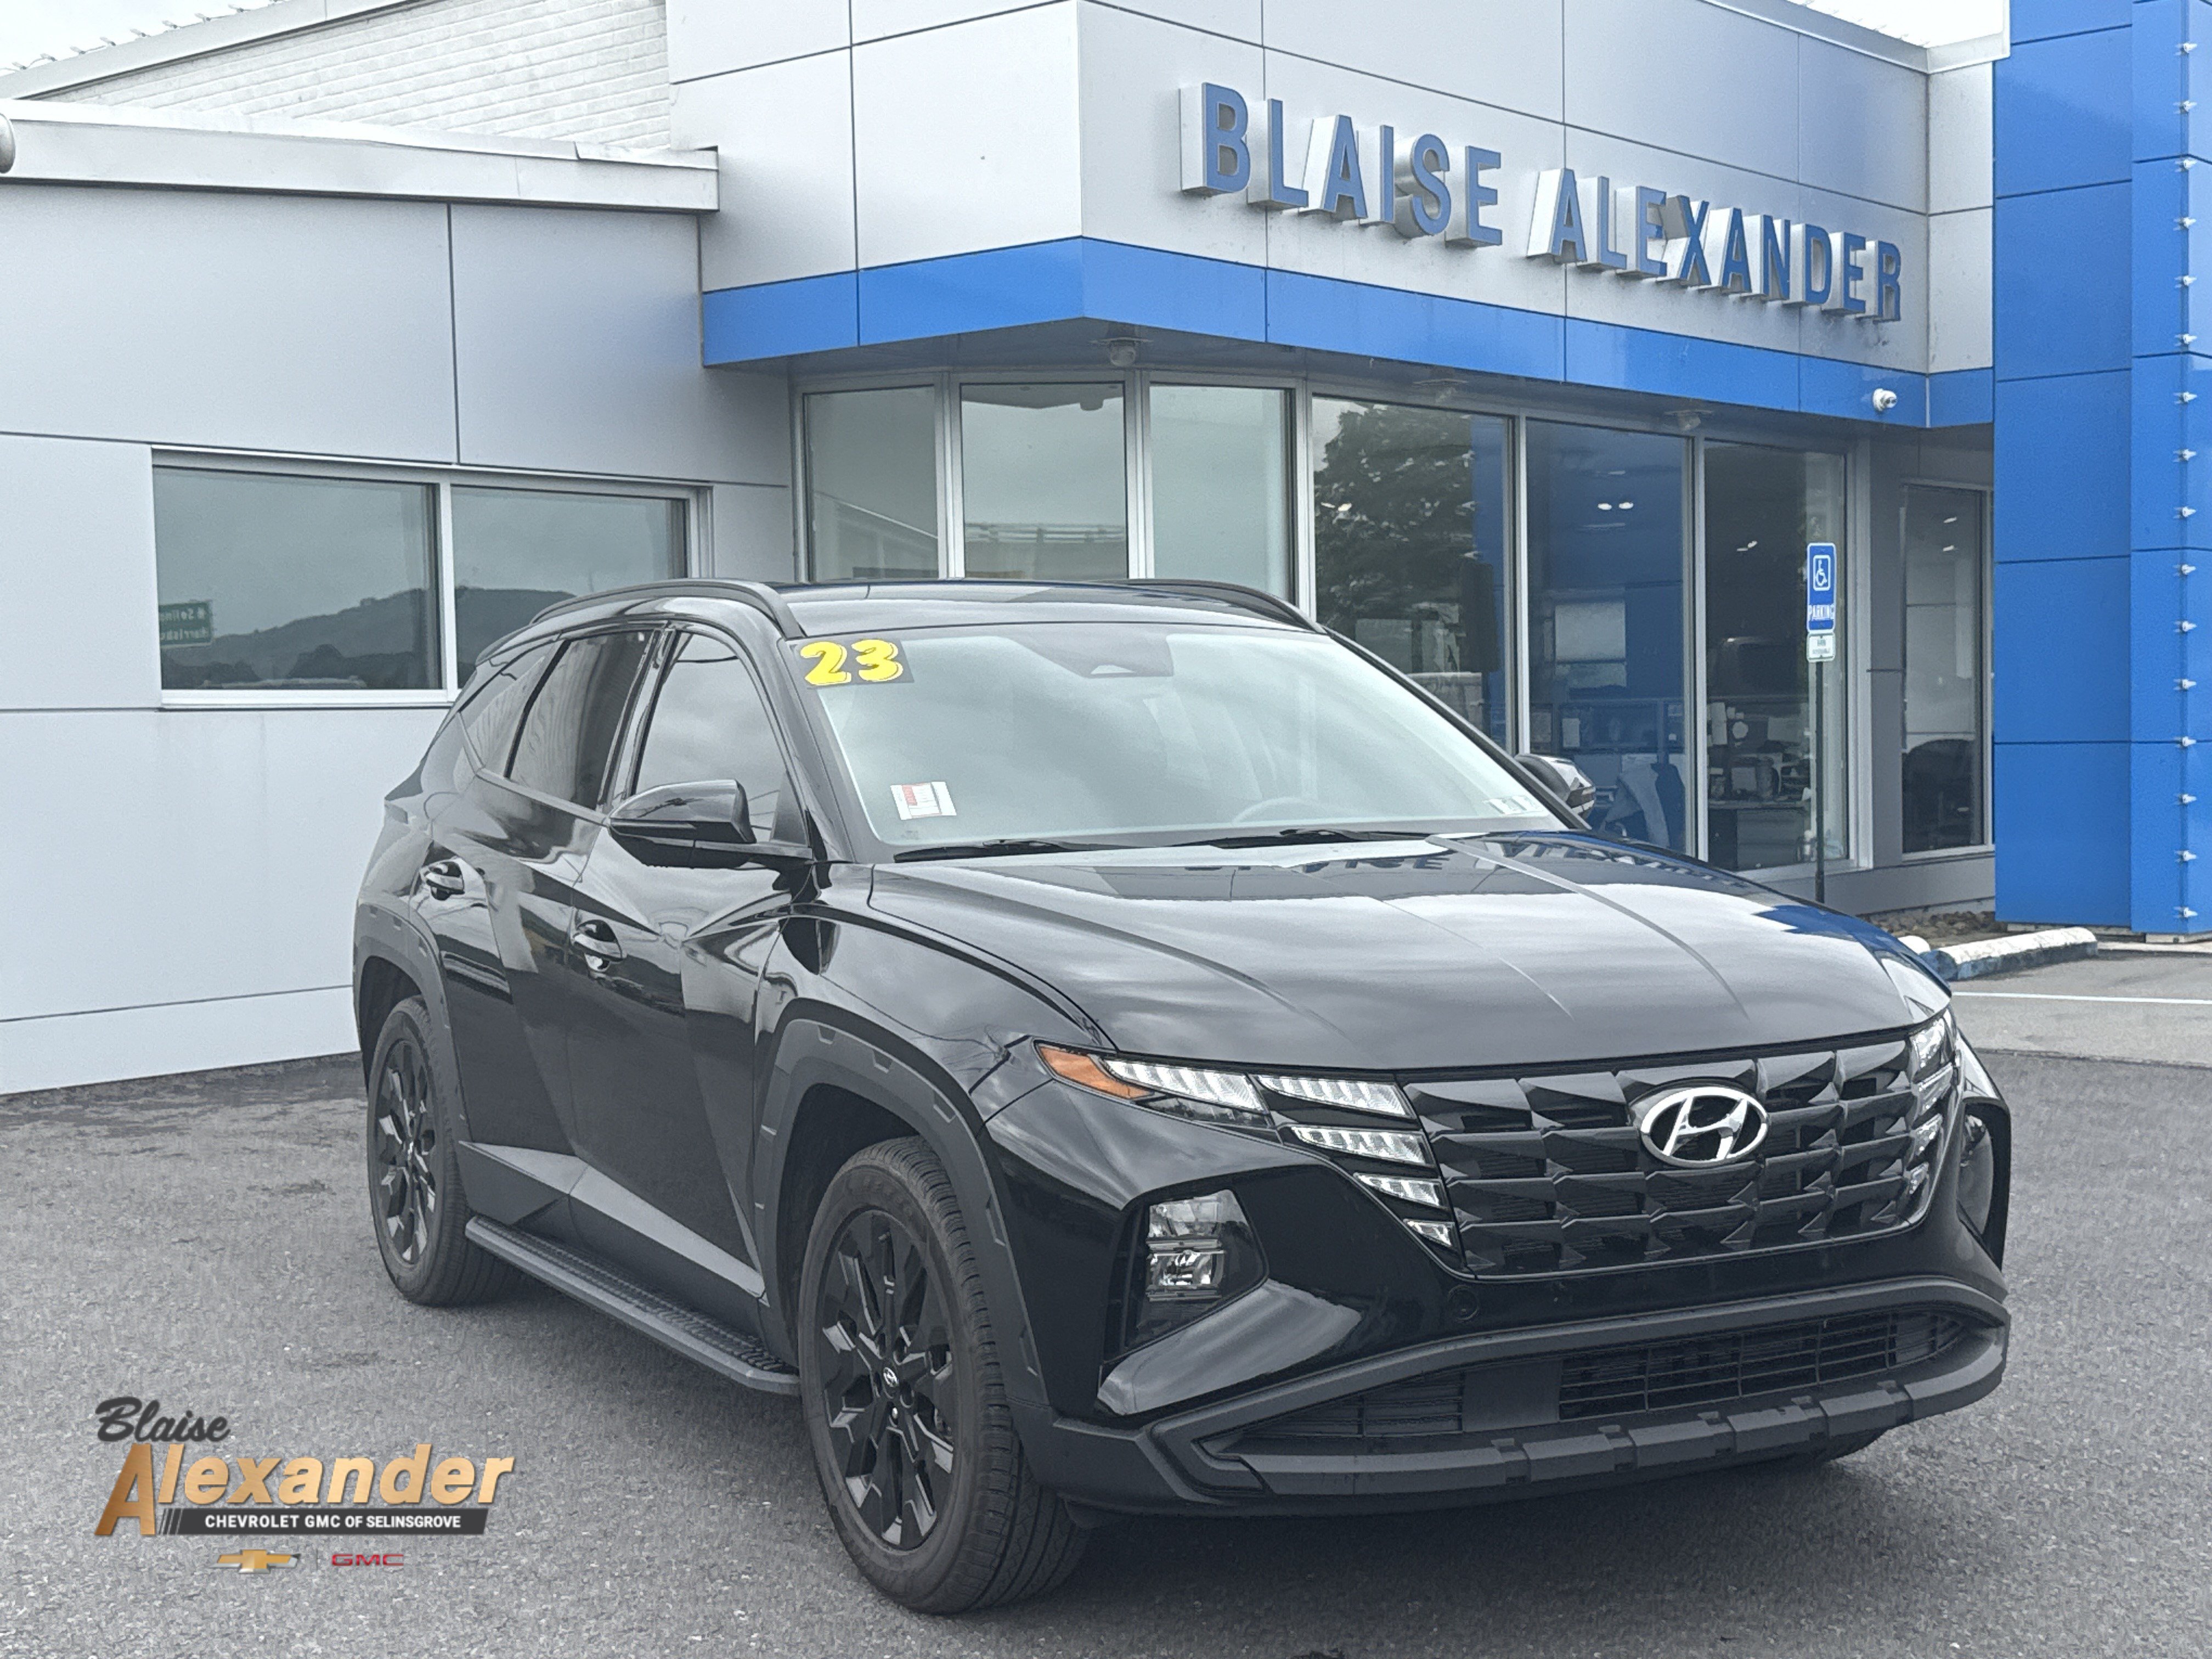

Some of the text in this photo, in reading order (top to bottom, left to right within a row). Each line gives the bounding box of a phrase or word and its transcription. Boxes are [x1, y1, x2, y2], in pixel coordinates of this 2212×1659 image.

[1200, 81, 1902, 323] BLAISE ALEXANDER
[800, 639, 904, 686] 23
